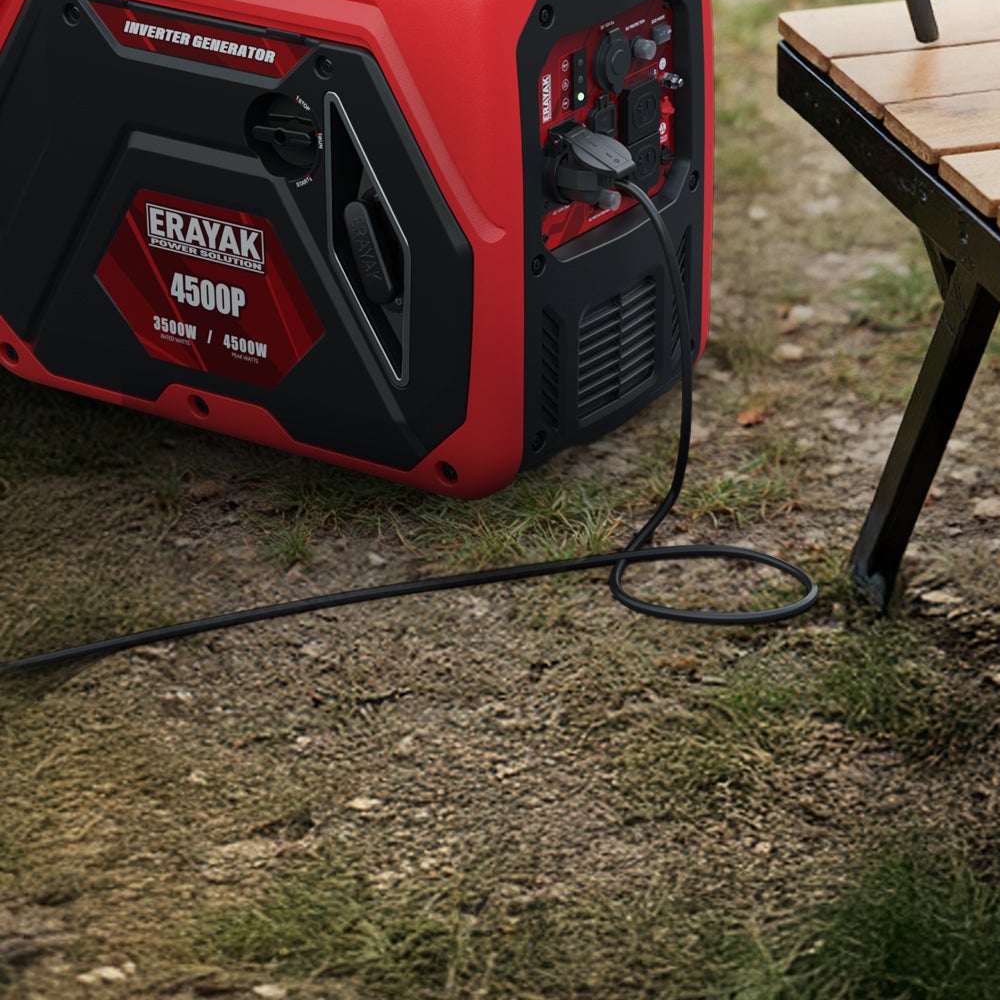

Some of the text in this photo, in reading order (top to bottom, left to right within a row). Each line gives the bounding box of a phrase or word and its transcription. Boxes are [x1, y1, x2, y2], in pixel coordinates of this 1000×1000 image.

[123, 20, 276, 64] INVERTER GENERATOR
[298, 98, 311, 111] STOP
[542, 74, 552, 123] ERAYAK
[296, 177, 310, 188] START
[149, 206, 261, 261] ERAYAK
[151, 237, 262, 271] POWER SOLUTION
[170, 272, 246, 318] 4500P
[153, 315, 267, 359] 3500W / 4500W
[175, 337, 191, 346] WATTS
[243, 355, 259, 364] WATTS
